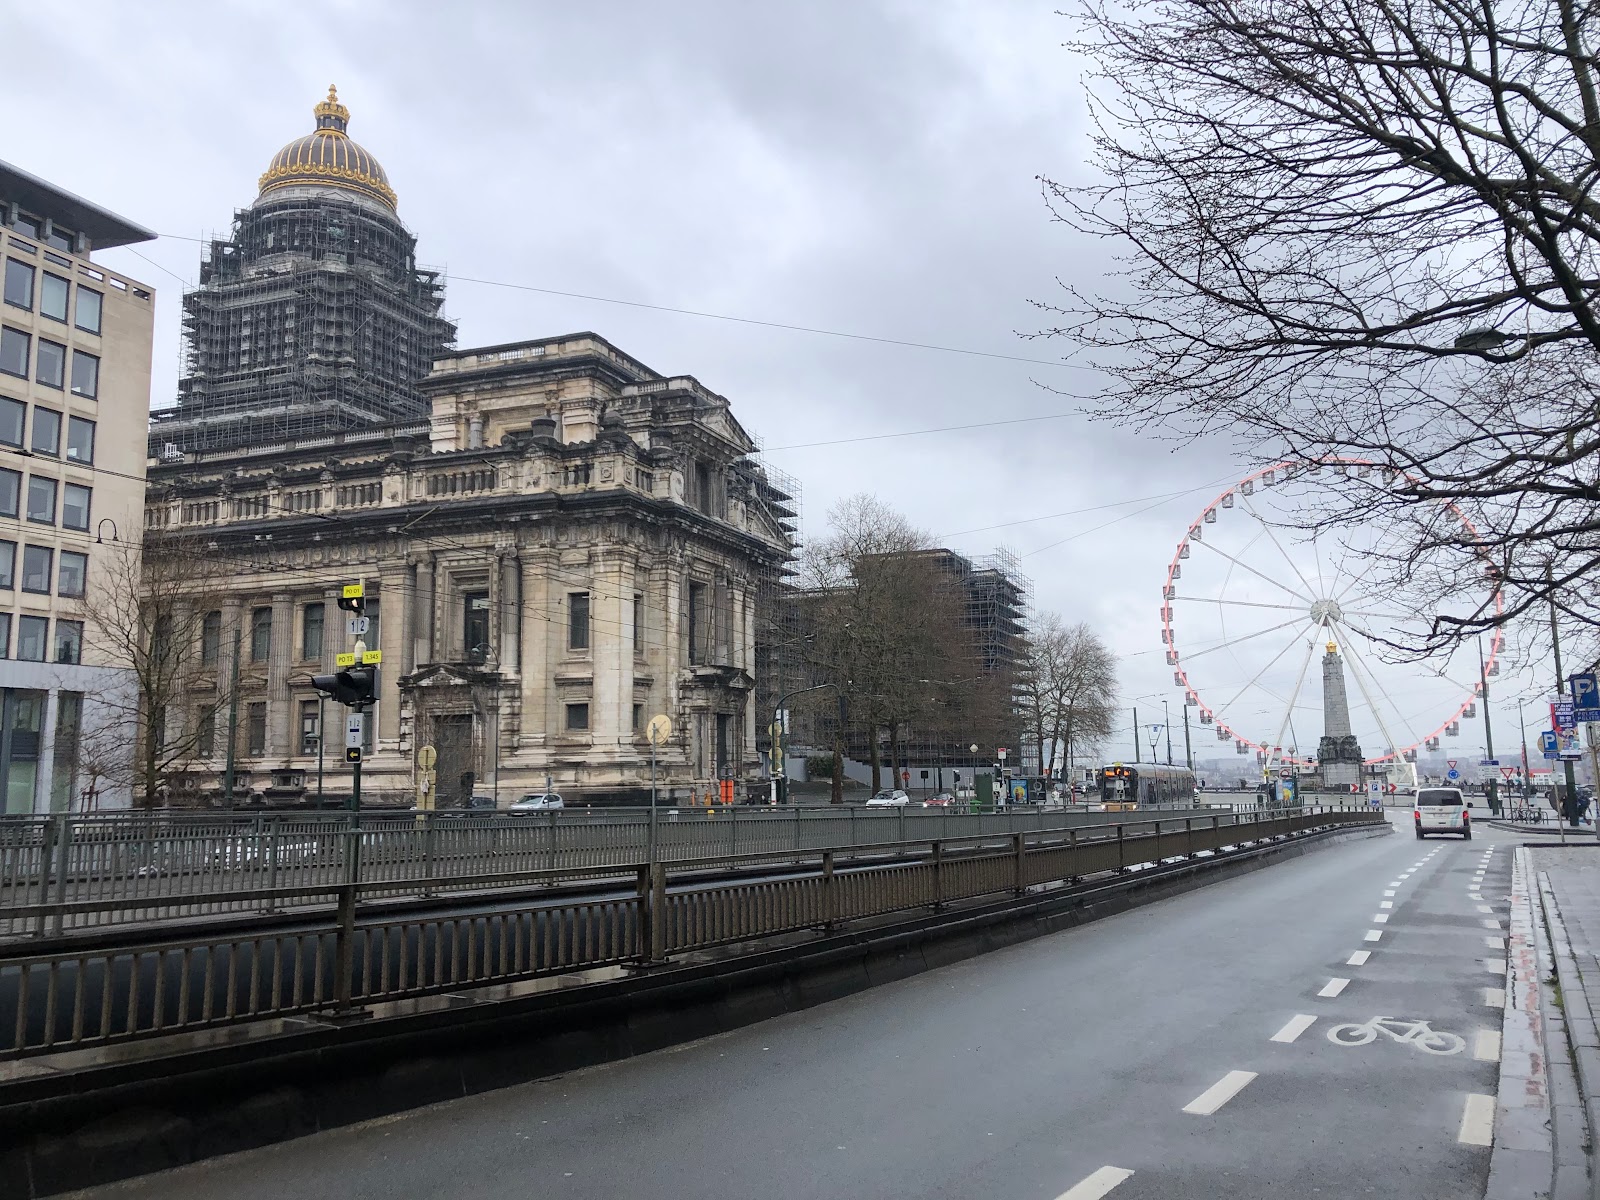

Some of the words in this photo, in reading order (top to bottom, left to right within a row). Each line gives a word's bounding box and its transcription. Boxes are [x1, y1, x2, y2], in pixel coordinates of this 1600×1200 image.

[351, 620, 355, 632] 1
[360, 620, 364, 632] 2
[1574, 679, 1594, 704] P
[1544, 734, 1555, 748] P
